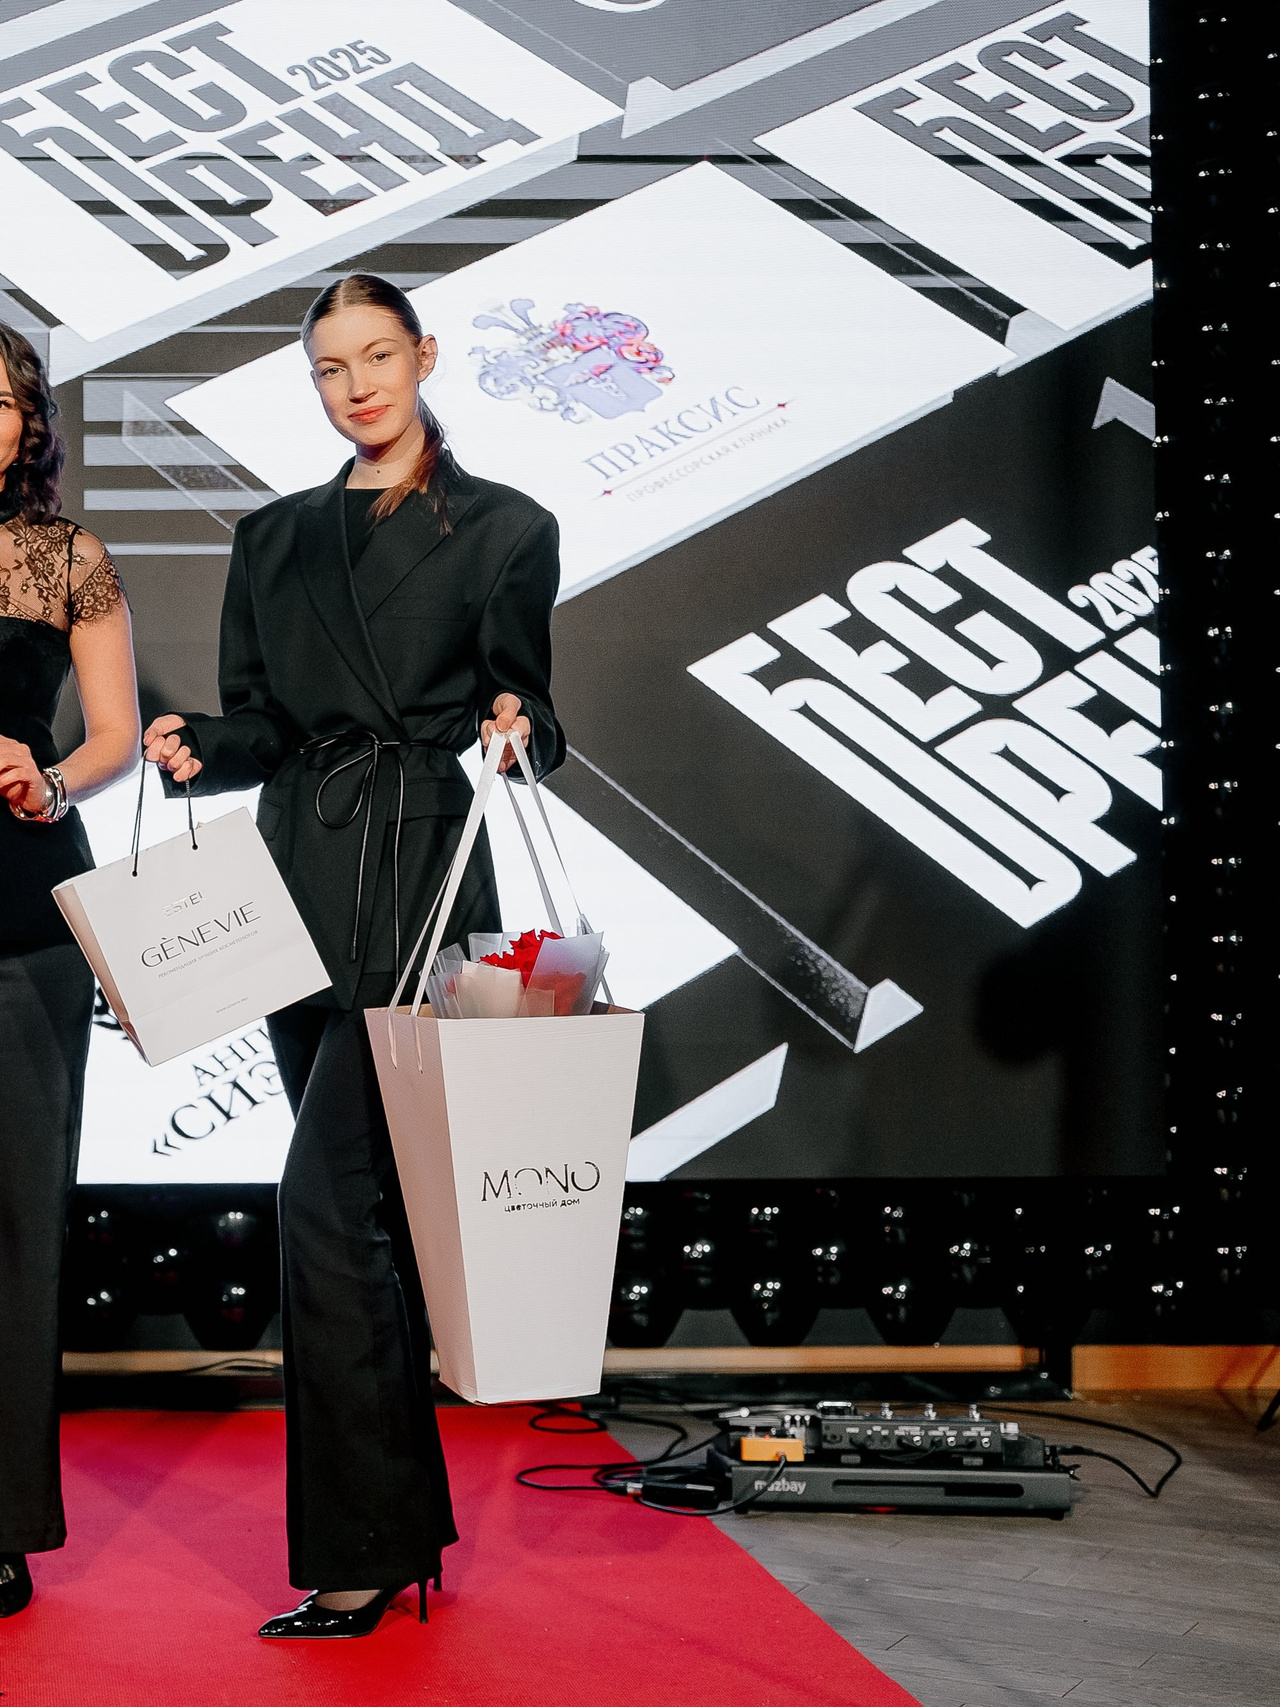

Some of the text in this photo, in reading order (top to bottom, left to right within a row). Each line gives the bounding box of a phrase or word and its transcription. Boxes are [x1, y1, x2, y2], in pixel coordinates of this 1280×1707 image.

[286, 39, 392, 91] 2025
[582, 386, 761, 480] ПРАКСИС
[625, 447, 731, 502] ПРОФЕССОРСКАЯ
[141, 901, 262, 968] GÈNEVIE
[504, 1198, 580, 1213] цветочный дом
